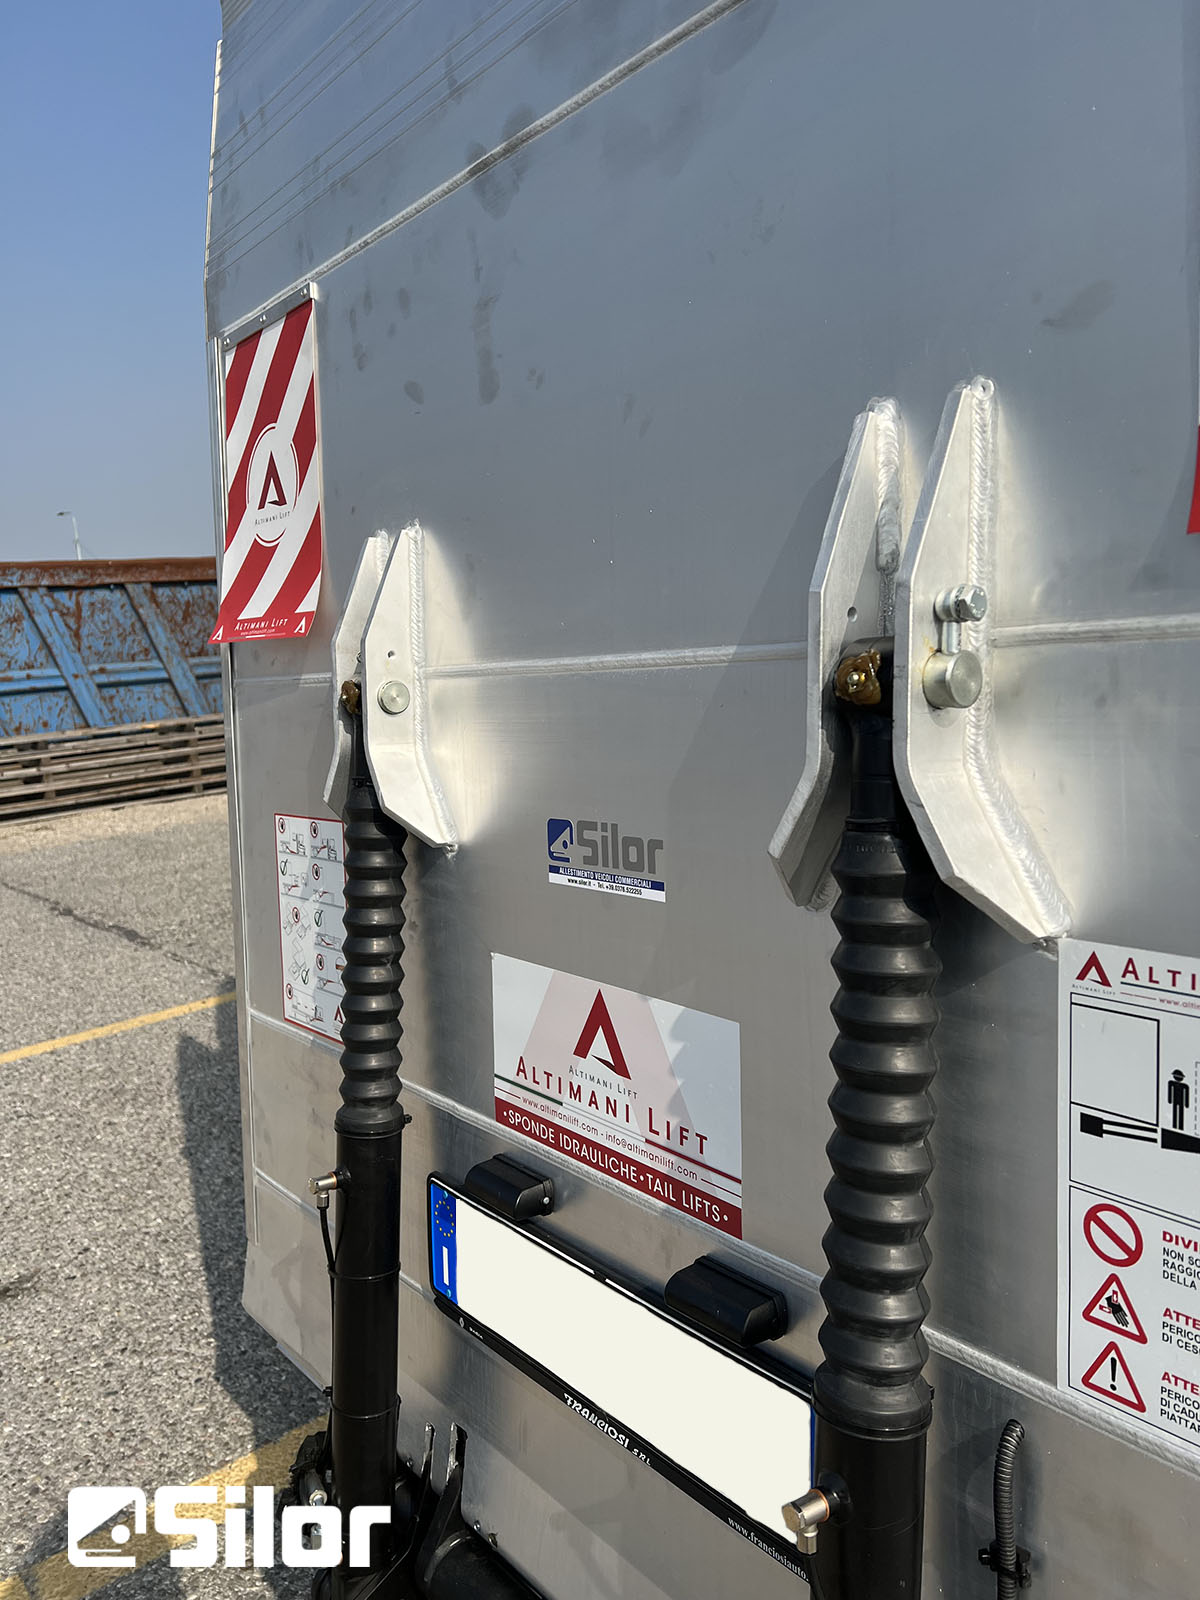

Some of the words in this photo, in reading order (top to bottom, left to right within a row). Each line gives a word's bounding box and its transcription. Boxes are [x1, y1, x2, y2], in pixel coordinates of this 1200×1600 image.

[234, 620, 269, 632] ALTIMANI
[271, 618, 288, 627] LIFT
[577, 820, 664, 874] Silor
[559, 866, 595, 880] ALLESTIMENTO
[595, 871, 614, 883] VEICOLI
[615, 875, 652, 888] COMMERCIALI
[568, 1065, 613, 1090] ALTIMANI
[617, 1083, 638, 1100] LIFT
[515, 1055, 631, 1124] ALTIMANI
[648, 1106, 708, 1155] LIFT
[522, 1096, 599, 1136] www.altimanilift.com
[605, 1131, 698, 1181] info@altimanilift.com
[1162, 1246, 1184, 1263] NON
[1162, 1269, 1197, 1291] DELLA
[1161, 1332, 1173, 1345] DI
[1176, 1338, 1200, 1357] CES
[1160, 1396, 1171, 1409] DI
[563, 1392, 630, 1448] FRANCIOSI
[631, 1448, 651, 1466] SRL
[727, 1517, 809, 1582] www.franciosiauto.
